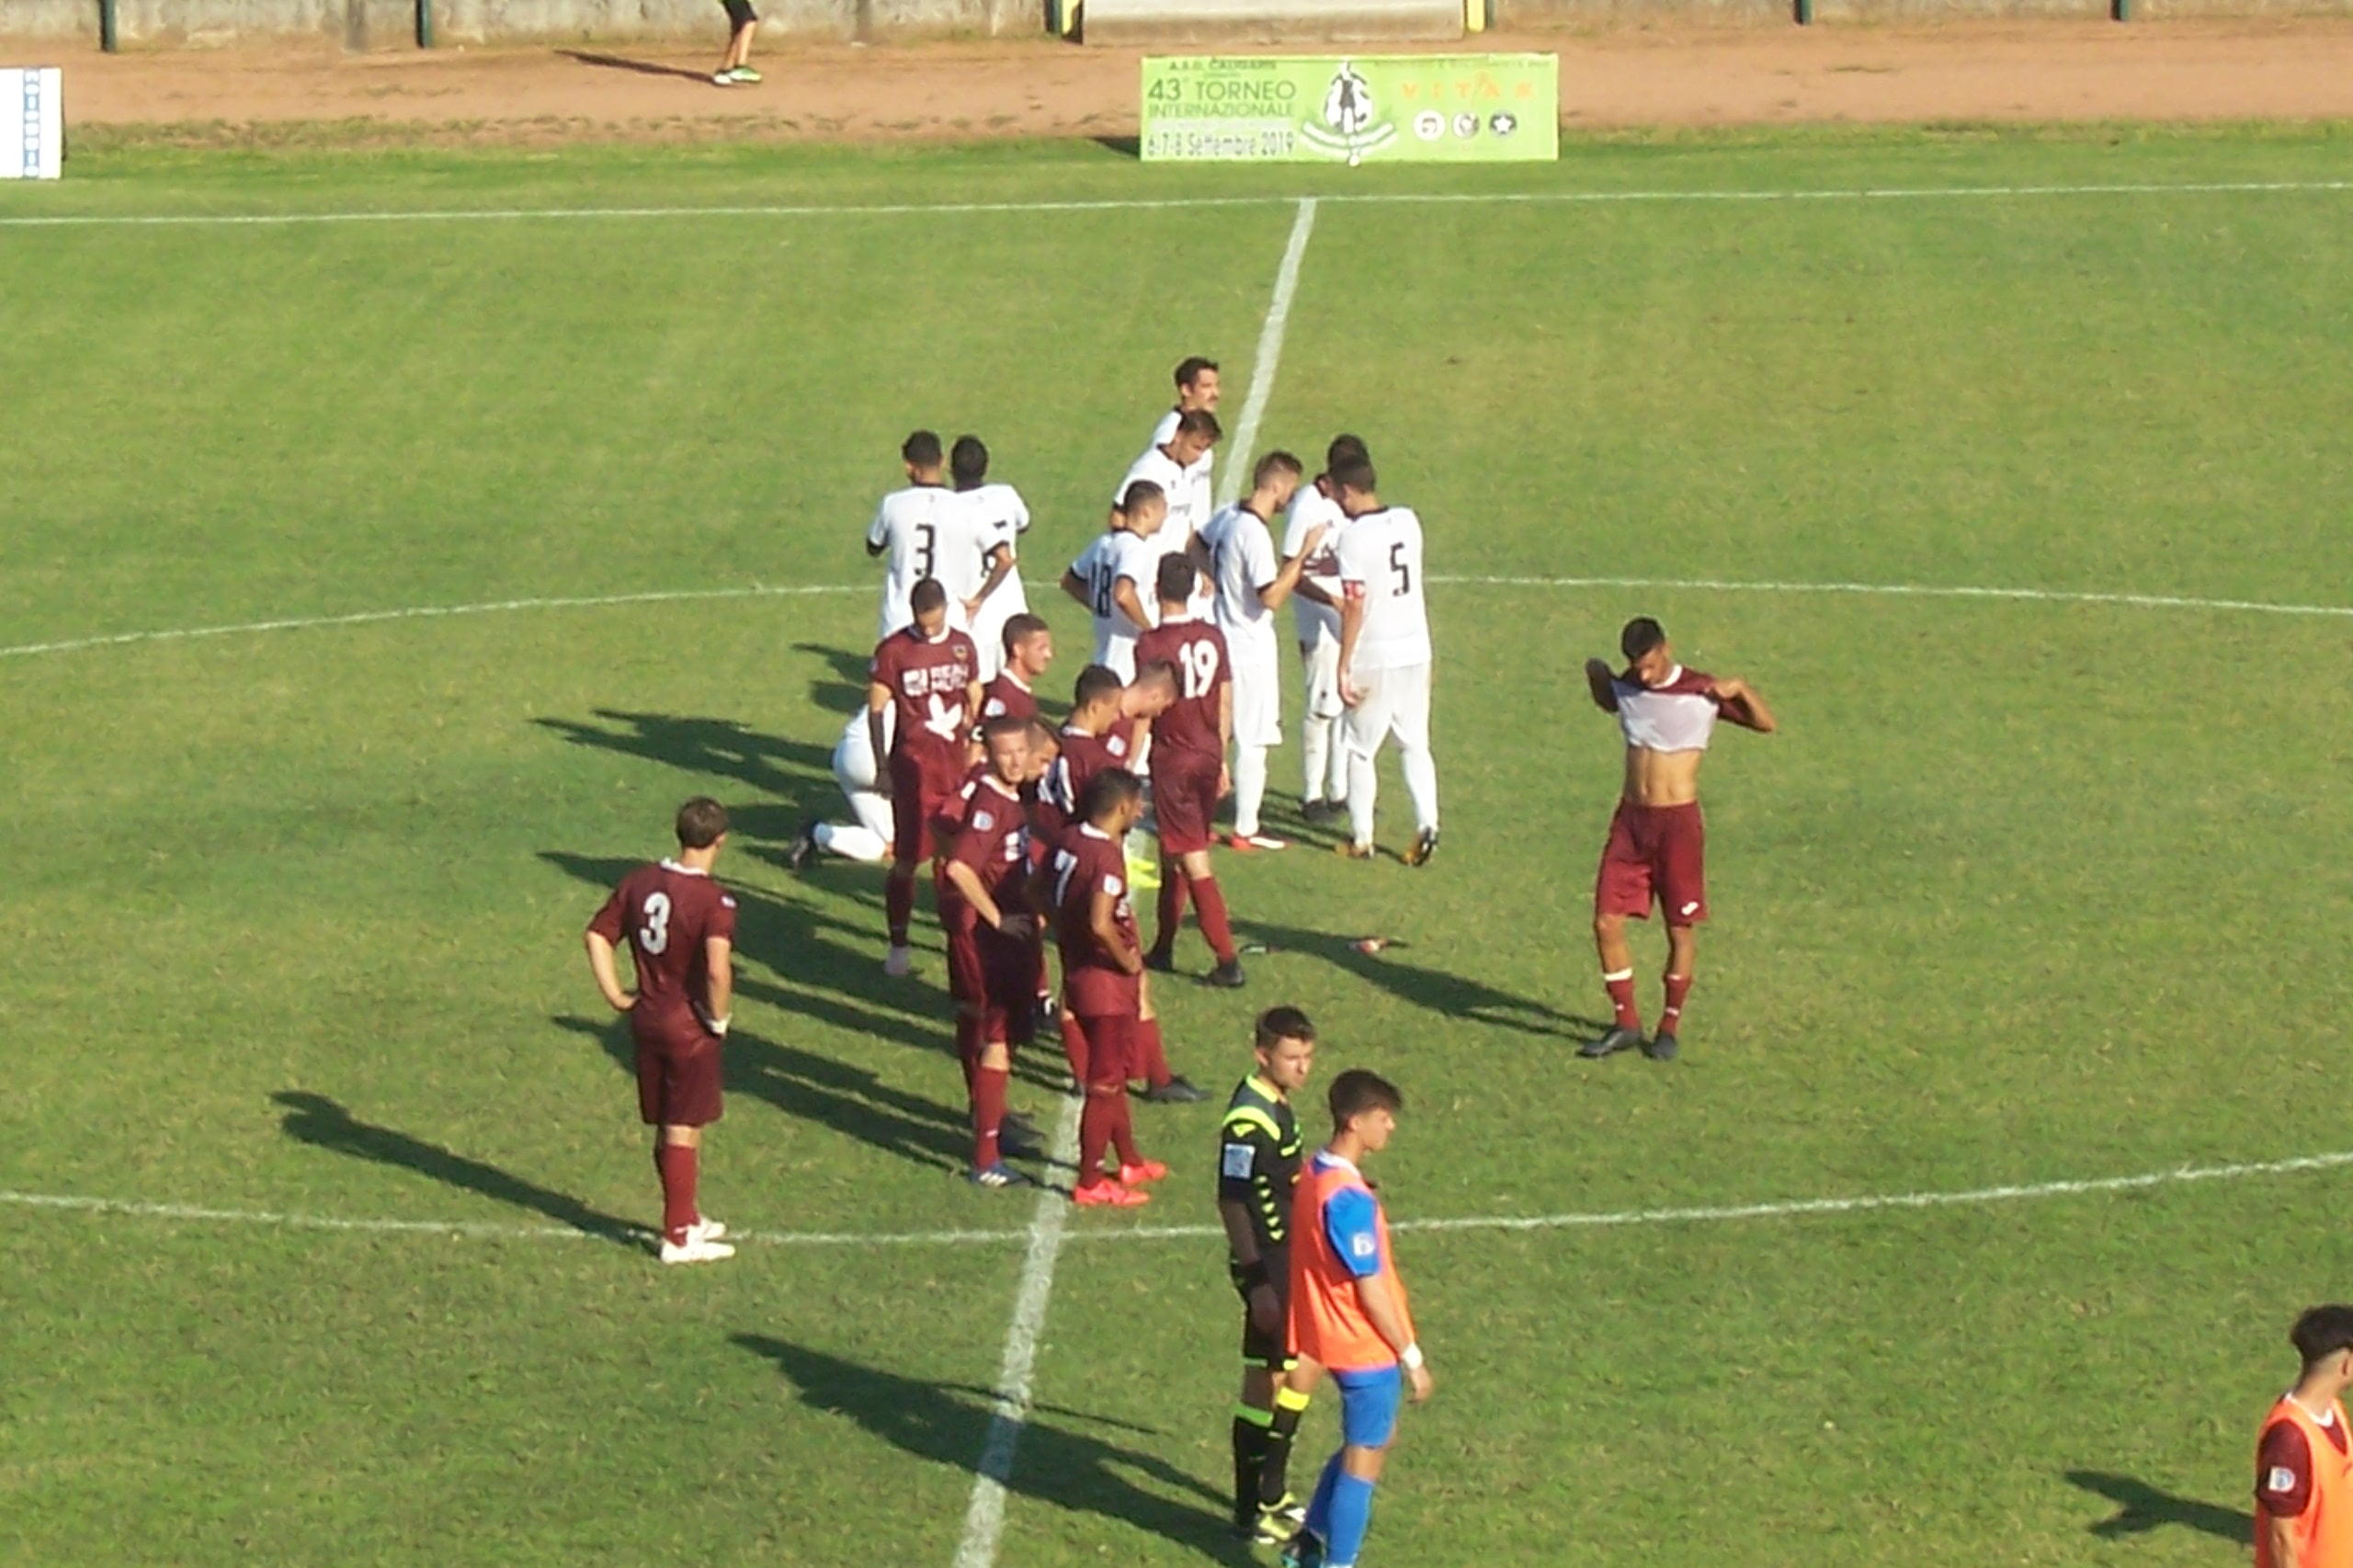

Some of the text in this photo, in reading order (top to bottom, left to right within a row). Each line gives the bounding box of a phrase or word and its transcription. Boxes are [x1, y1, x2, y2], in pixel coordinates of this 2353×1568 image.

[1148, 103, 1295, 119] INTERNAZIONALE
[1196, 80, 1297, 101] TORNEO
[1261, 131, 1294, 157] 2019
[915, 523, 936, 579] 3
[1389, 542, 1409, 597] 5
[1179, 640, 1220, 699] 19
[640, 891, 672, 956] 3
